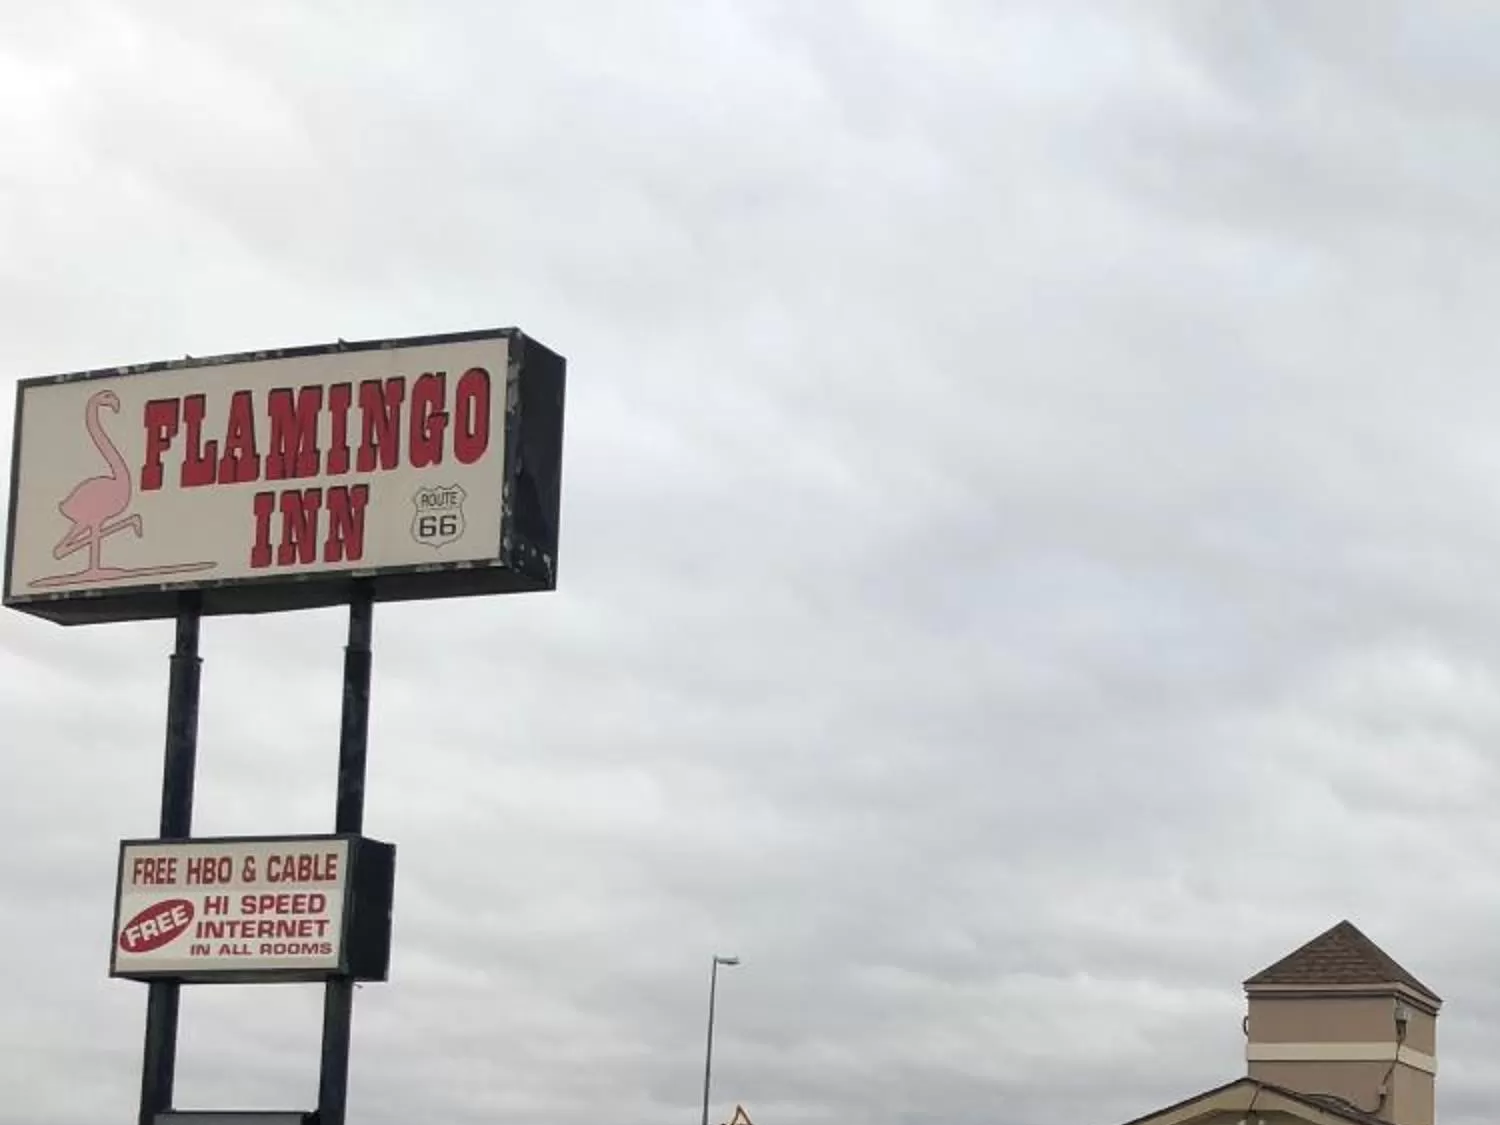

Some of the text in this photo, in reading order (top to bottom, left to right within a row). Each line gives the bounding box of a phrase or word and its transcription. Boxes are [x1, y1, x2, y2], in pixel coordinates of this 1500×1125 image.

[141, 367, 492, 491] FLAMINGO
[420, 491, 459, 508] ROUTE
[250, 483, 370, 569] INN
[420, 515, 457, 537] 66
[132, 853, 339, 885] FREE HBO & CABLE
[203, 893, 327, 915] HI SPEED
[124, 904, 190, 948] FREE
[195, 919, 330, 939] INTERNET
[190, 942, 333, 956] IN ALL ROOMS
